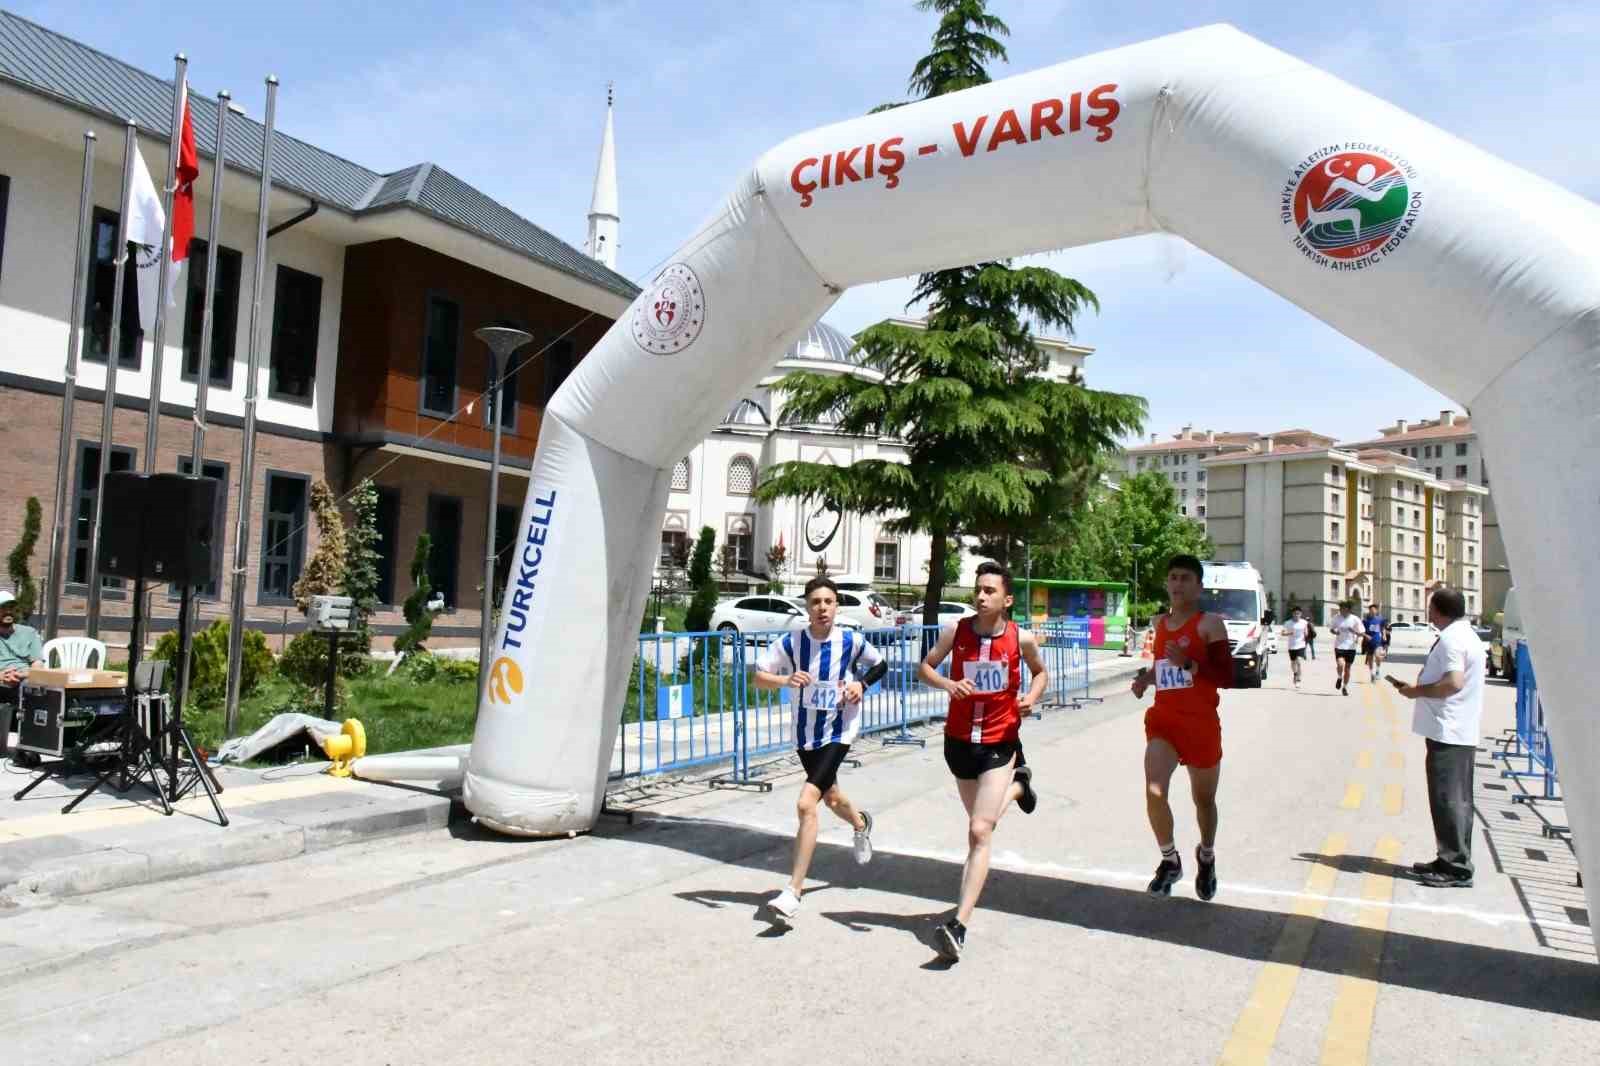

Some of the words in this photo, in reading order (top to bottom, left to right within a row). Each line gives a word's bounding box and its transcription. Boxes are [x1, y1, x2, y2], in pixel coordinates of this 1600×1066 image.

[790, 136, 905, 208] ÇIKIŞ
[952, 83, 1121, 158] VARIŞ
[1331, 252, 1380, 271] ATHLETIC
[1380, 191, 1424, 256] FEDERATION
[501, 490, 557, 650] TURKCELL
[810, 688, 837, 709] 412
[974, 669, 1002, 691] 410
[1160, 666, 1185, 687] 414
